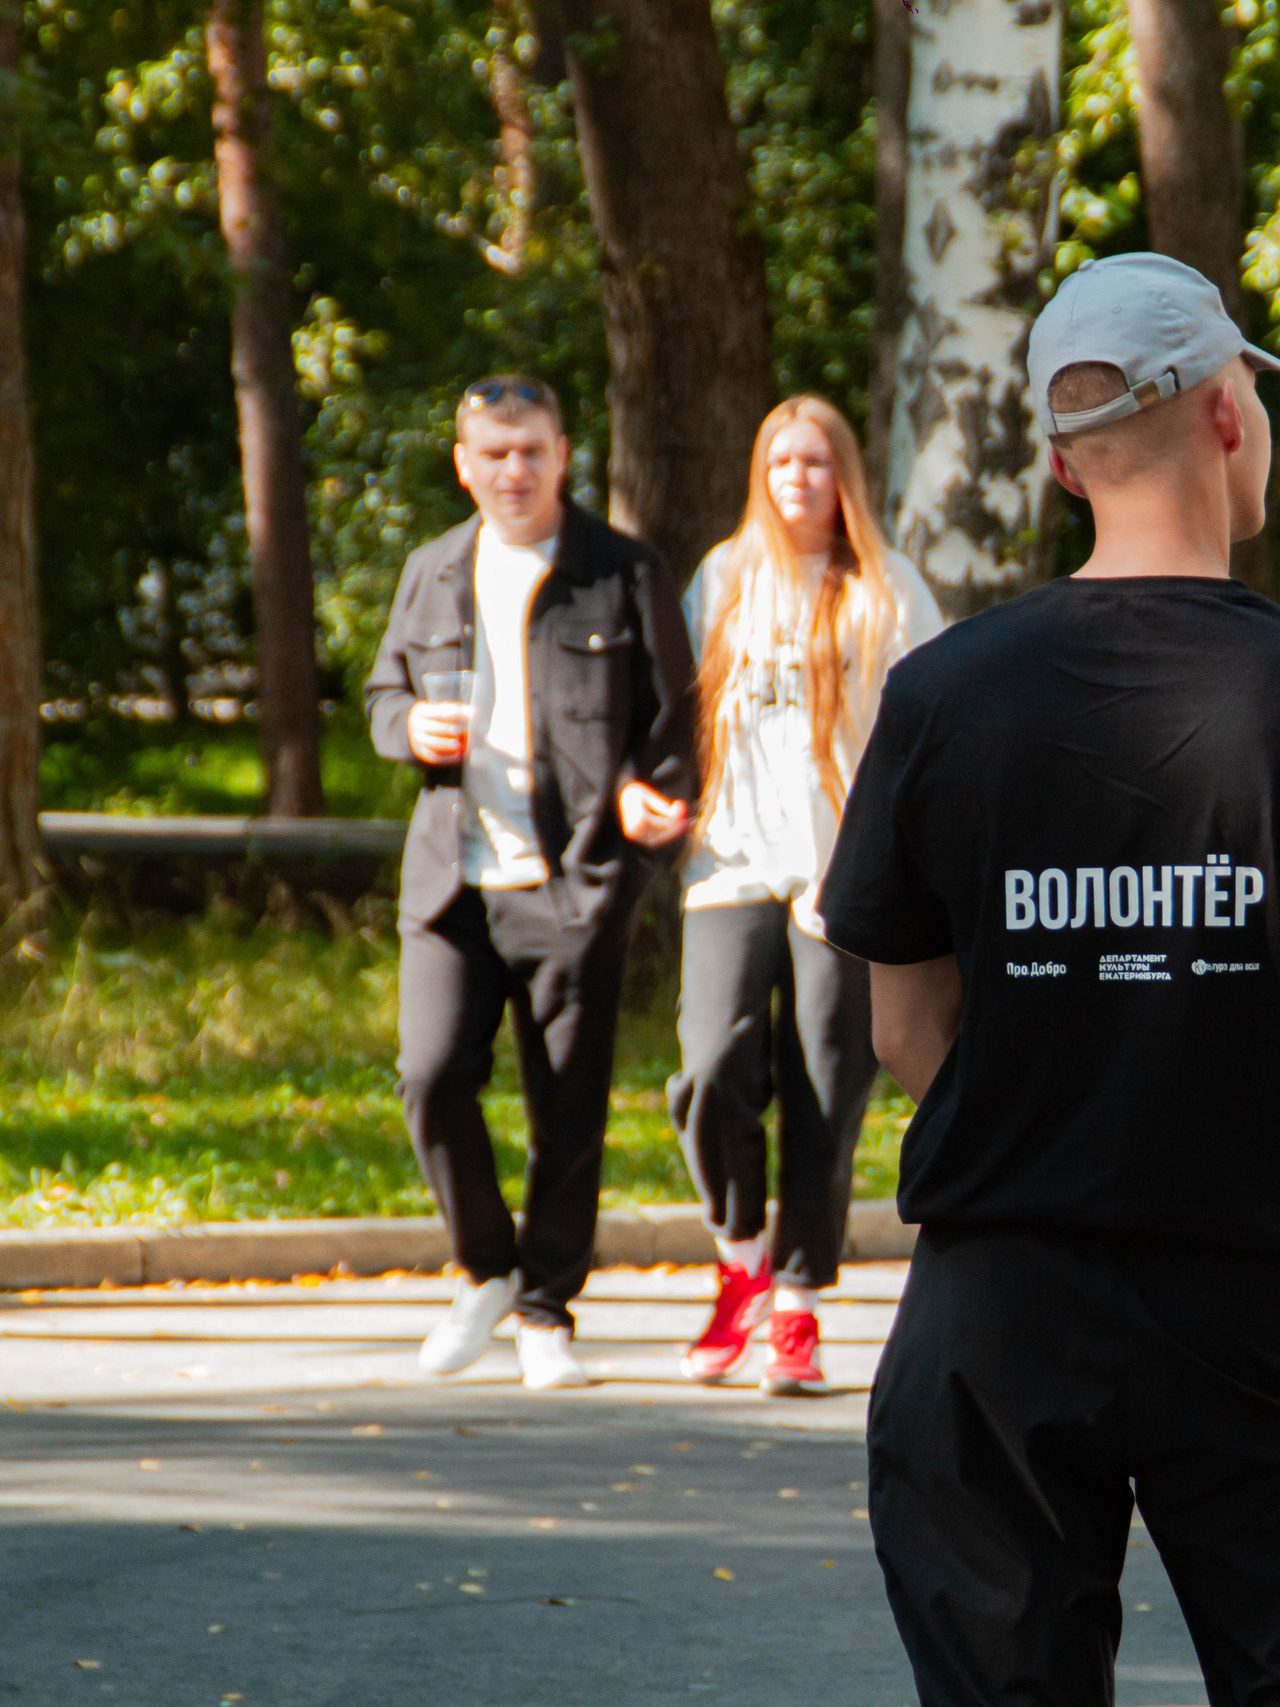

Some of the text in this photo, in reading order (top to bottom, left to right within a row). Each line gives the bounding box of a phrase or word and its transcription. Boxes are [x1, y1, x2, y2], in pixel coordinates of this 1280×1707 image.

[1005, 854, 1265, 930] ВОЛОНТЁР
[1099, 954, 1168, 963] ДЕПАРТАМЕНТ
[1099, 963, 1151, 972] КУЛЬТУРЫ
[1099, 971, 1172, 981] ЕКАТЕРИНБУРГА
